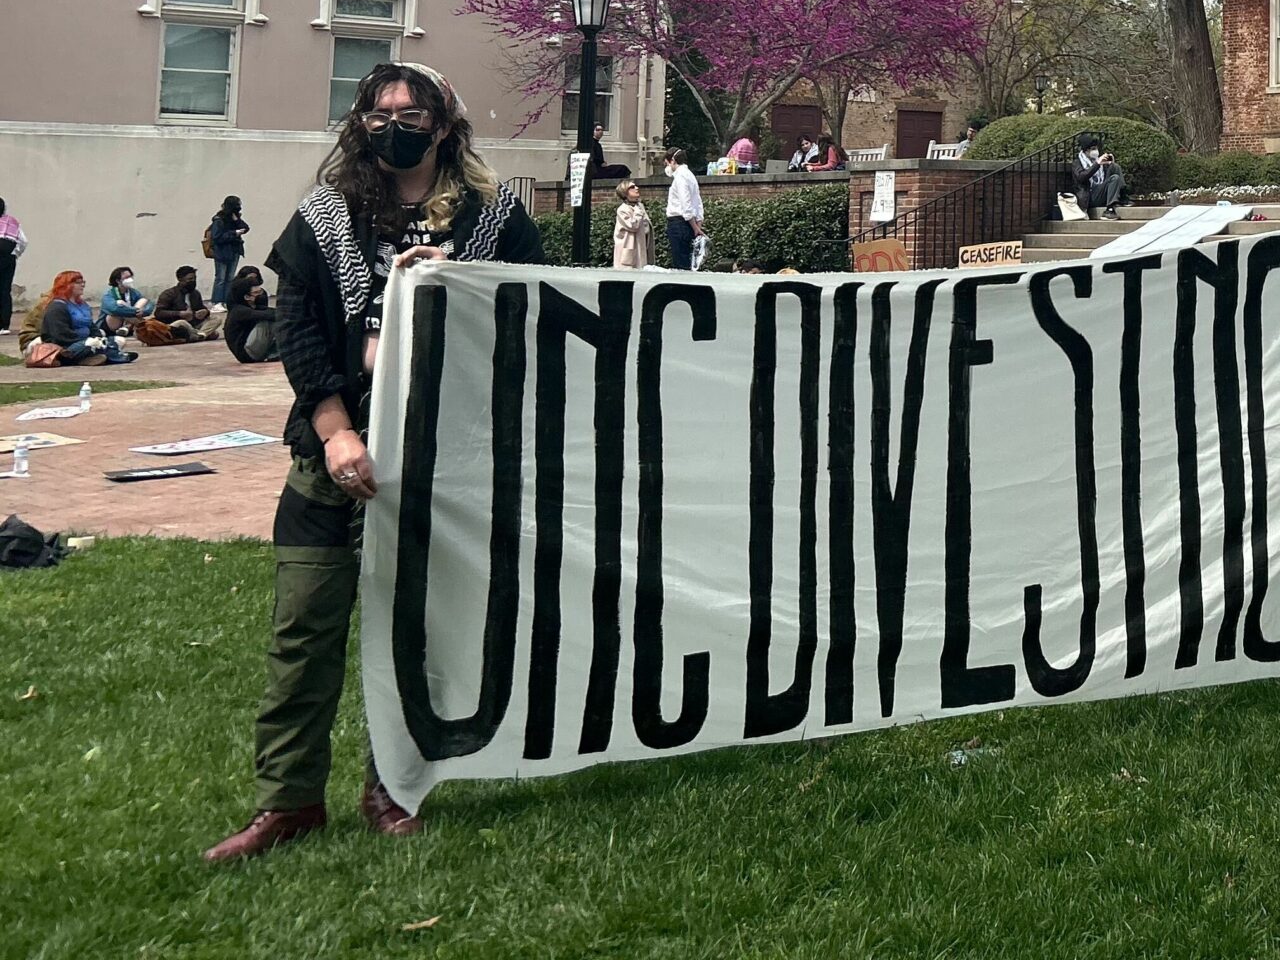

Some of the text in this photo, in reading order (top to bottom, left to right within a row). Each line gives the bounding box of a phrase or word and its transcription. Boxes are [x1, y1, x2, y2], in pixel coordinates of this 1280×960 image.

[401, 234, 431, 244] ARE
[960, 245, 1021, 264] CEASEFIRE
[391, 279, 716, 761] UNC
[743, 257, 1161, 738] DIVEST
